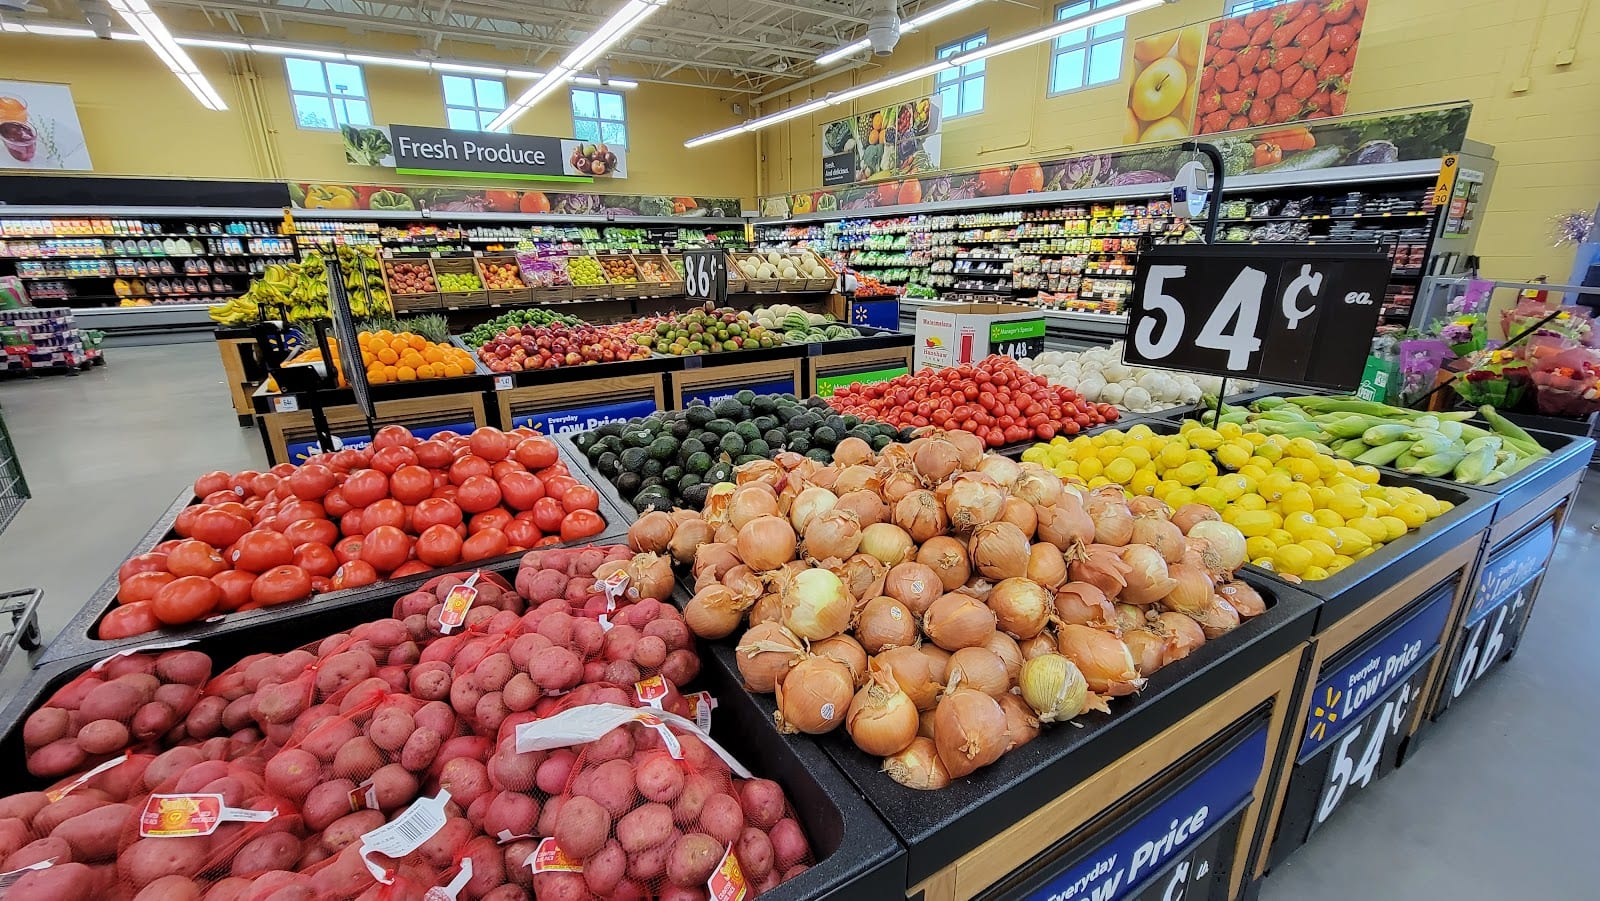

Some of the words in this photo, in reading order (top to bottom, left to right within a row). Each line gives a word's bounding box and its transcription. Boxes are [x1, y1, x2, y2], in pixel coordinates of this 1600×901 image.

[398, 136, 458, 160] Fresh
[463, 141, 546, 165] Produce
[1438, 183, 1448, 192] A
[1434, 194, 1447, 204] 30
[1344, 290, 1374, 306] ea.
[1000, 327, 1020, 336] Manager's
[1020, 325, 1034, 334] Special
[548, 415, 578, 424] Everyday
[549, 422, 584, 436] Low
[587, 415, 627, 430] Price
[1342, 671, 1383, 720] Low
[1381, 639, 1422, 687] Price
[1348, 656, 1381, 687] Everyday
[1127, 805, 1208, 884] Price
